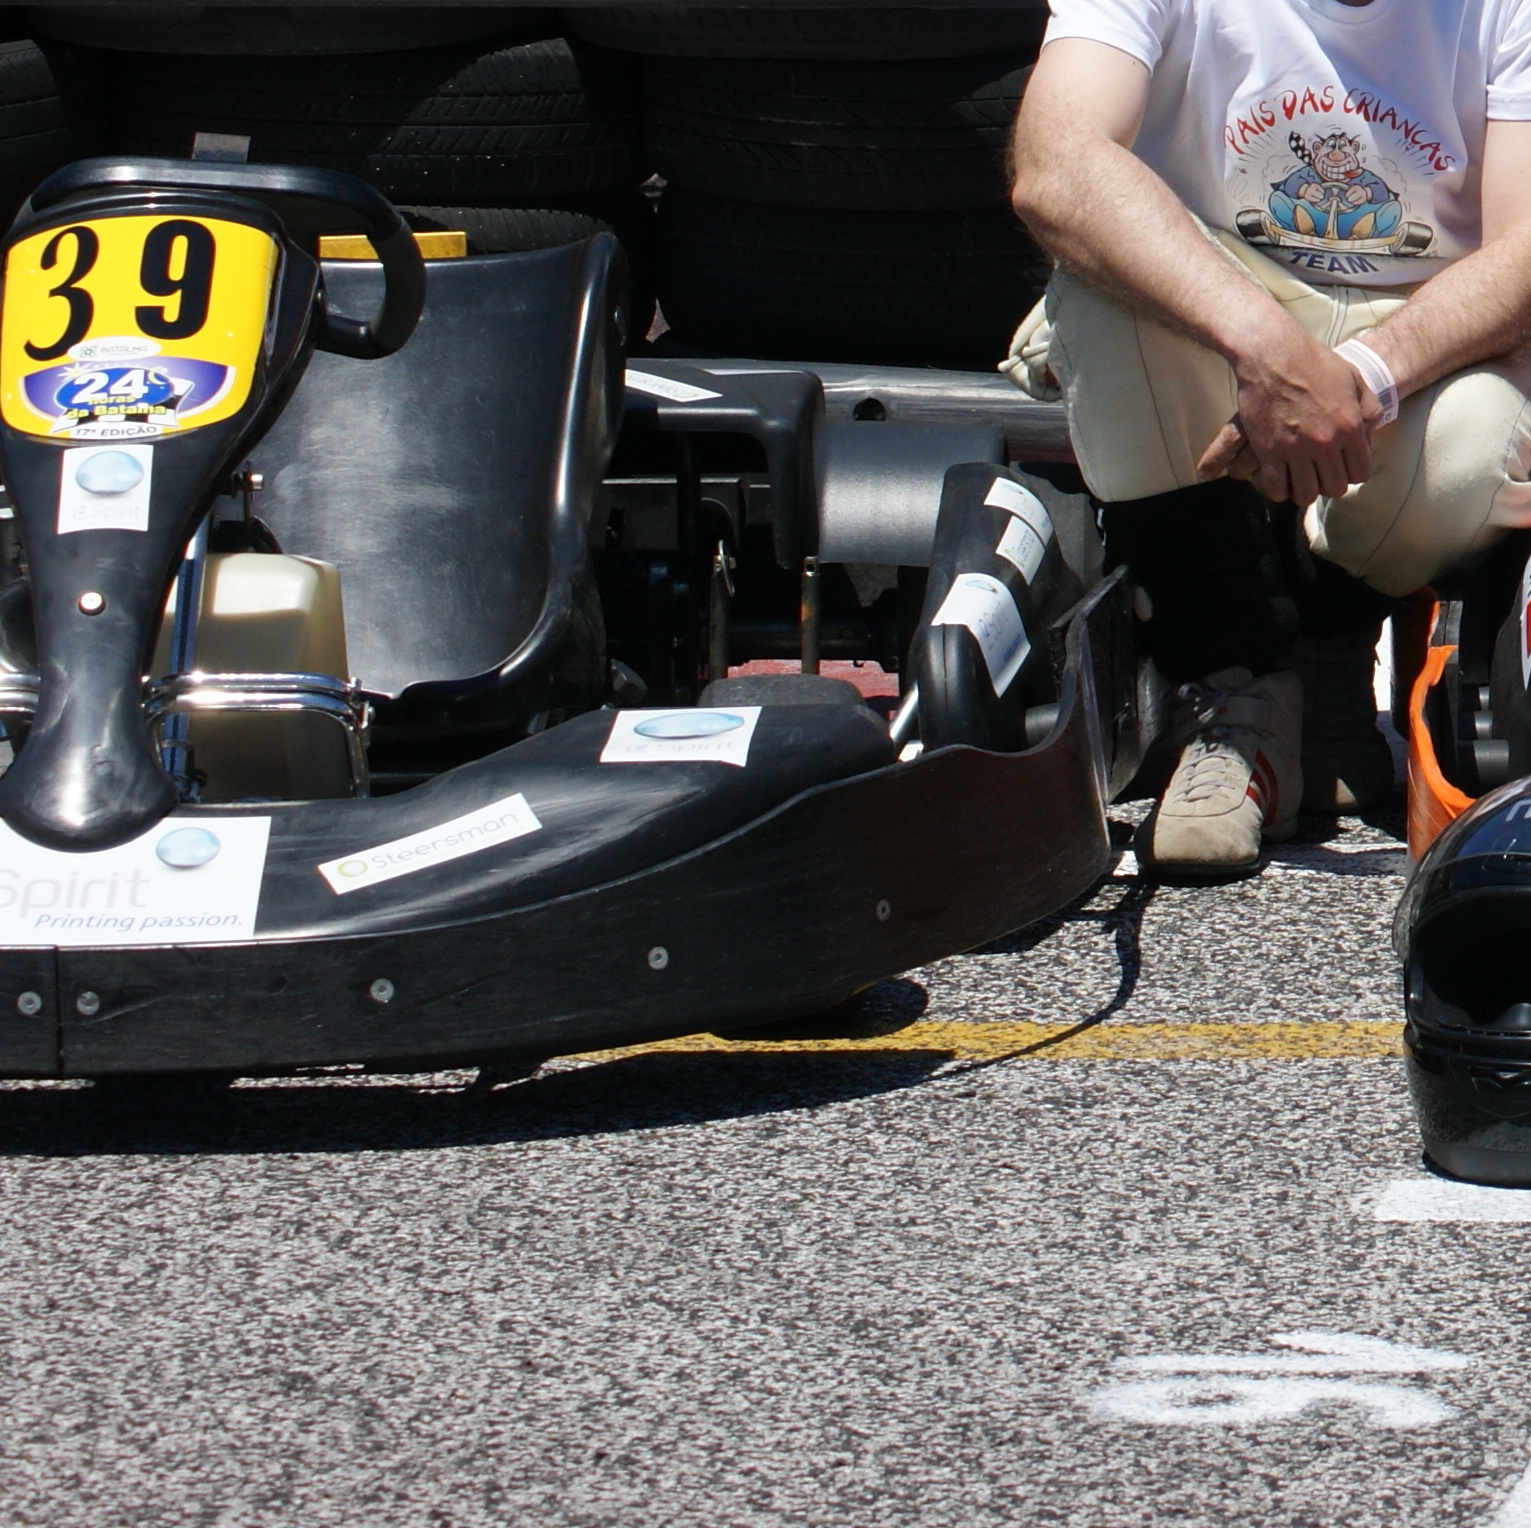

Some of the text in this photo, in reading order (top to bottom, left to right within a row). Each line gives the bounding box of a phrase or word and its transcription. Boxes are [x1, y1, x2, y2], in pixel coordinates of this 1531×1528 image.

[1223, 85, 1456, 172] PAIS DAS CRIANÇAS
[1290, 252, 1380, 273] TEAM
[24, 219, 217, 361] 39
[71, 369, 149, 404] 24
[87, 395, 136, 405] horas
[66, 403, 167, 419] da Batalha
[101, 425, 158, 437] EDIÇÃO
[90, 504, 141, 521] Spirit
[371, 813, 520, 870] Steersman
[35, 913, 243, 932] Printing passion.
